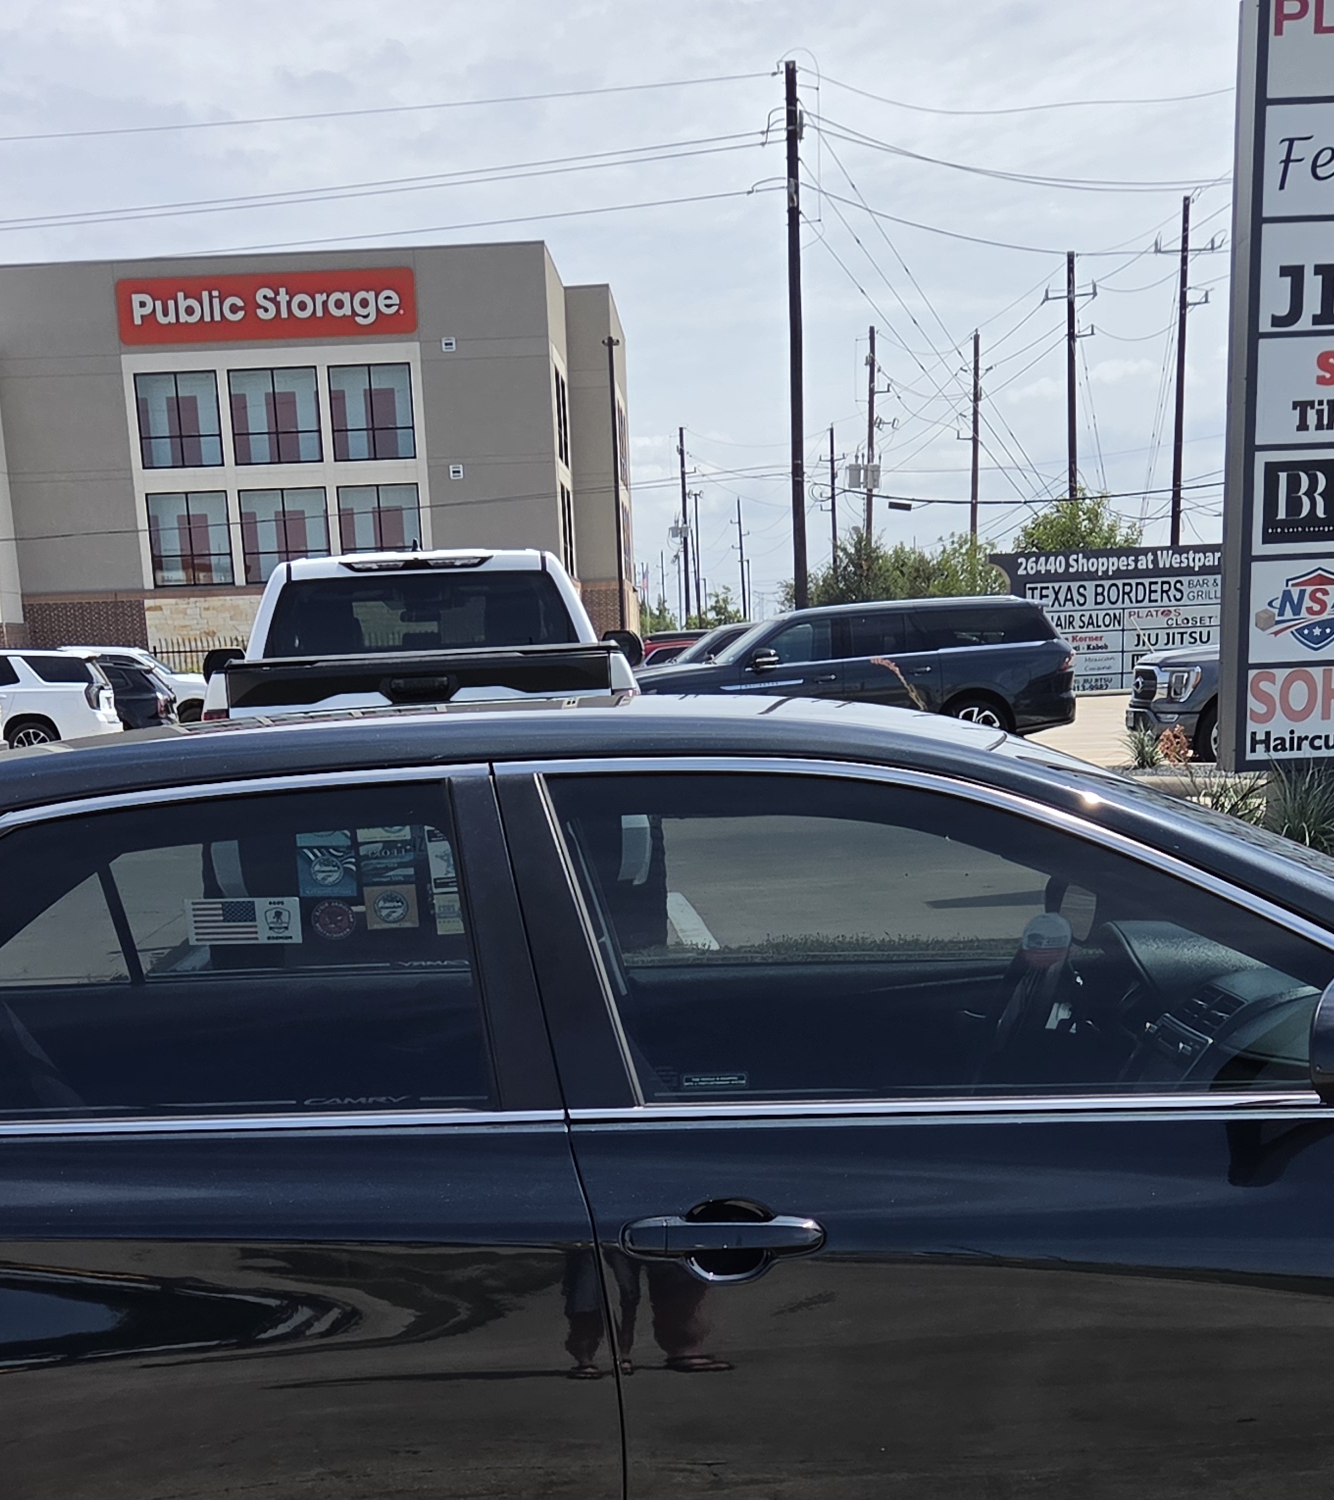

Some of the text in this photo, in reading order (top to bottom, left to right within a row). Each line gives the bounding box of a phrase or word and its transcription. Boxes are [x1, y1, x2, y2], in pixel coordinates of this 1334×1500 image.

[131, 287, 401, 325] Public Storage
[1017, 549, 1221, 576] 26440 Shoppes at Westpar
[1027, 578, 1219, 608] TEXAS BORDERS BAR &
[1187, 589, 1221, 601] GRILL
[1051, 612, 1122, 630] AIR SALON
[1166, 615, 1214, 627] CLOSET
[1134, 630, 1211, 648] JIU JITSU
[304, 1094, 410, 1106] CAMRY
